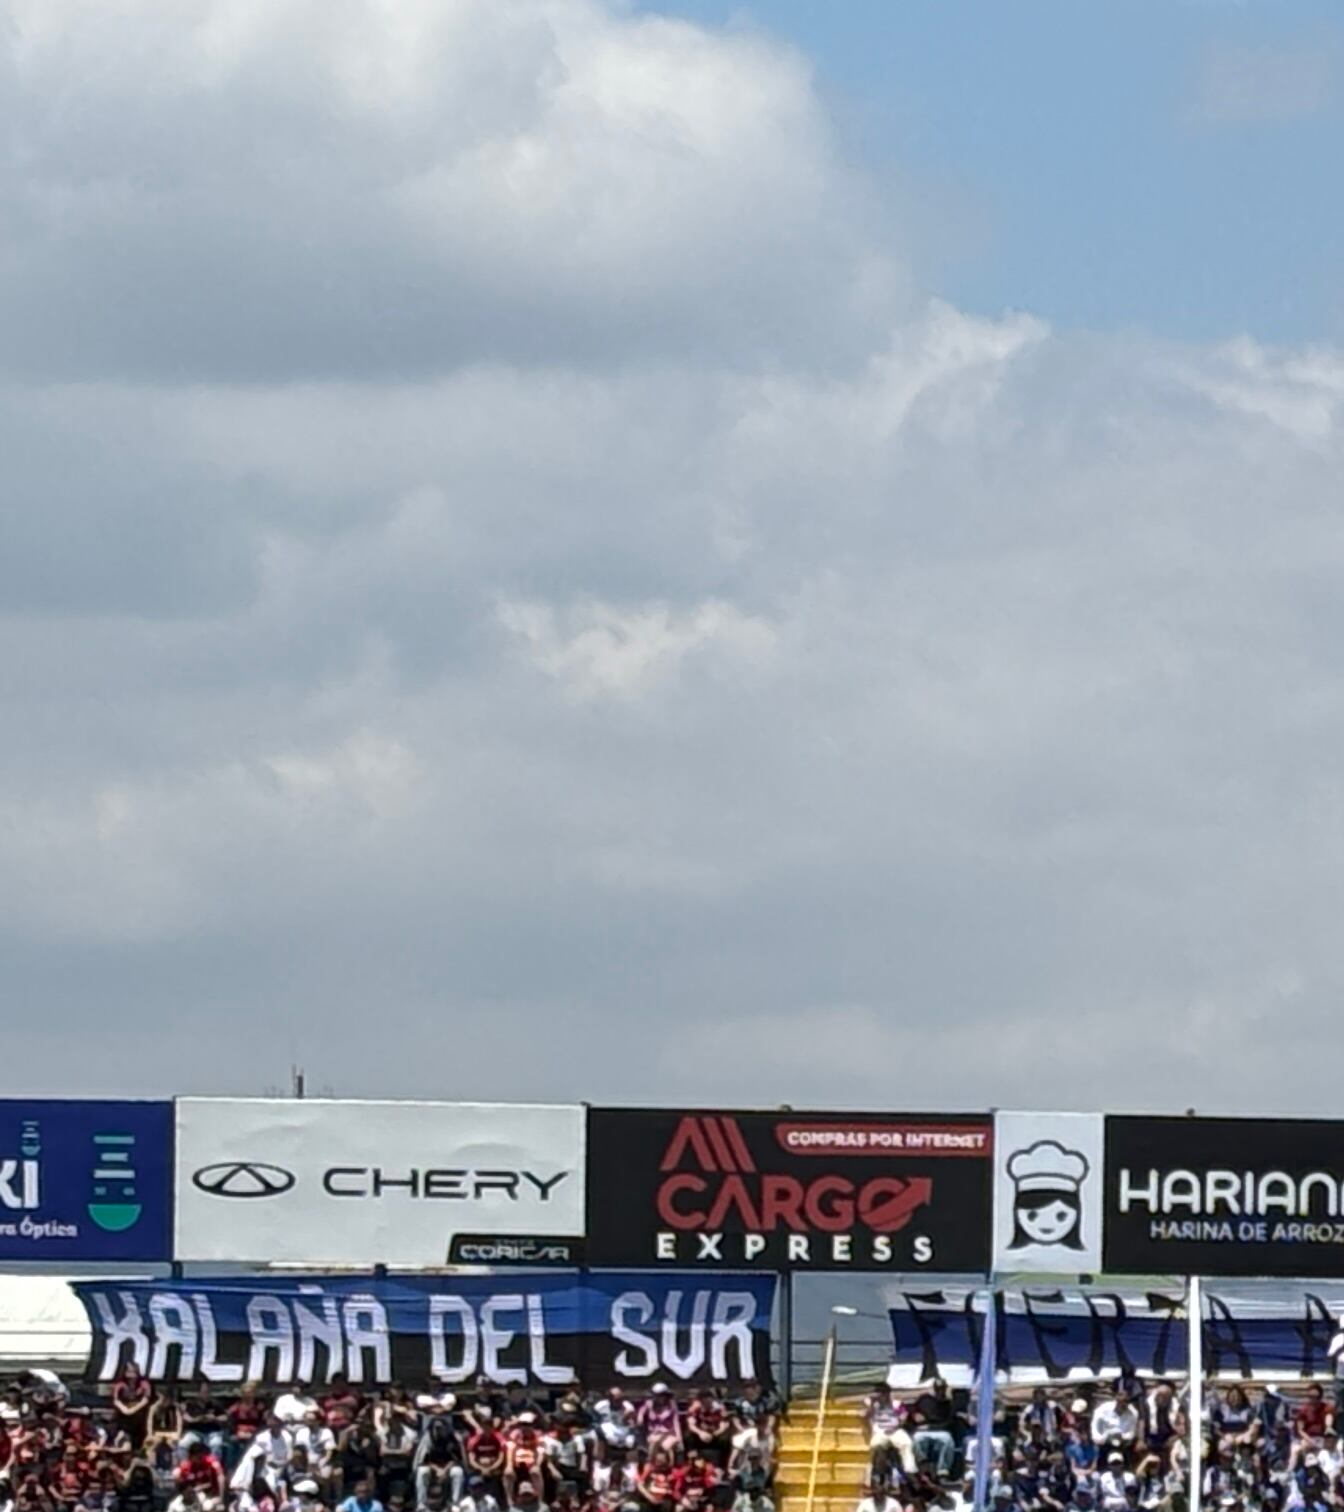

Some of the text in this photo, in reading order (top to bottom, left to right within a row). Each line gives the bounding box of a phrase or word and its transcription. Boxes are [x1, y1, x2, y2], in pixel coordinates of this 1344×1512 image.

[787, 1131, 984, 1149] COMPRAS POR INTERNET
[323, 1167, 570, 1200] CHERY
[657, 1174, 933, 1232] CARGO
[1150, 1220, 1233, 1241] HARINA
[1238, 1222, 1267, 1242] DE
[656, 1232, 933, 1263] EXPRESS
[428, 1294, 575, 1384] DEL
[611, 1289, 758, 1383] SUR
